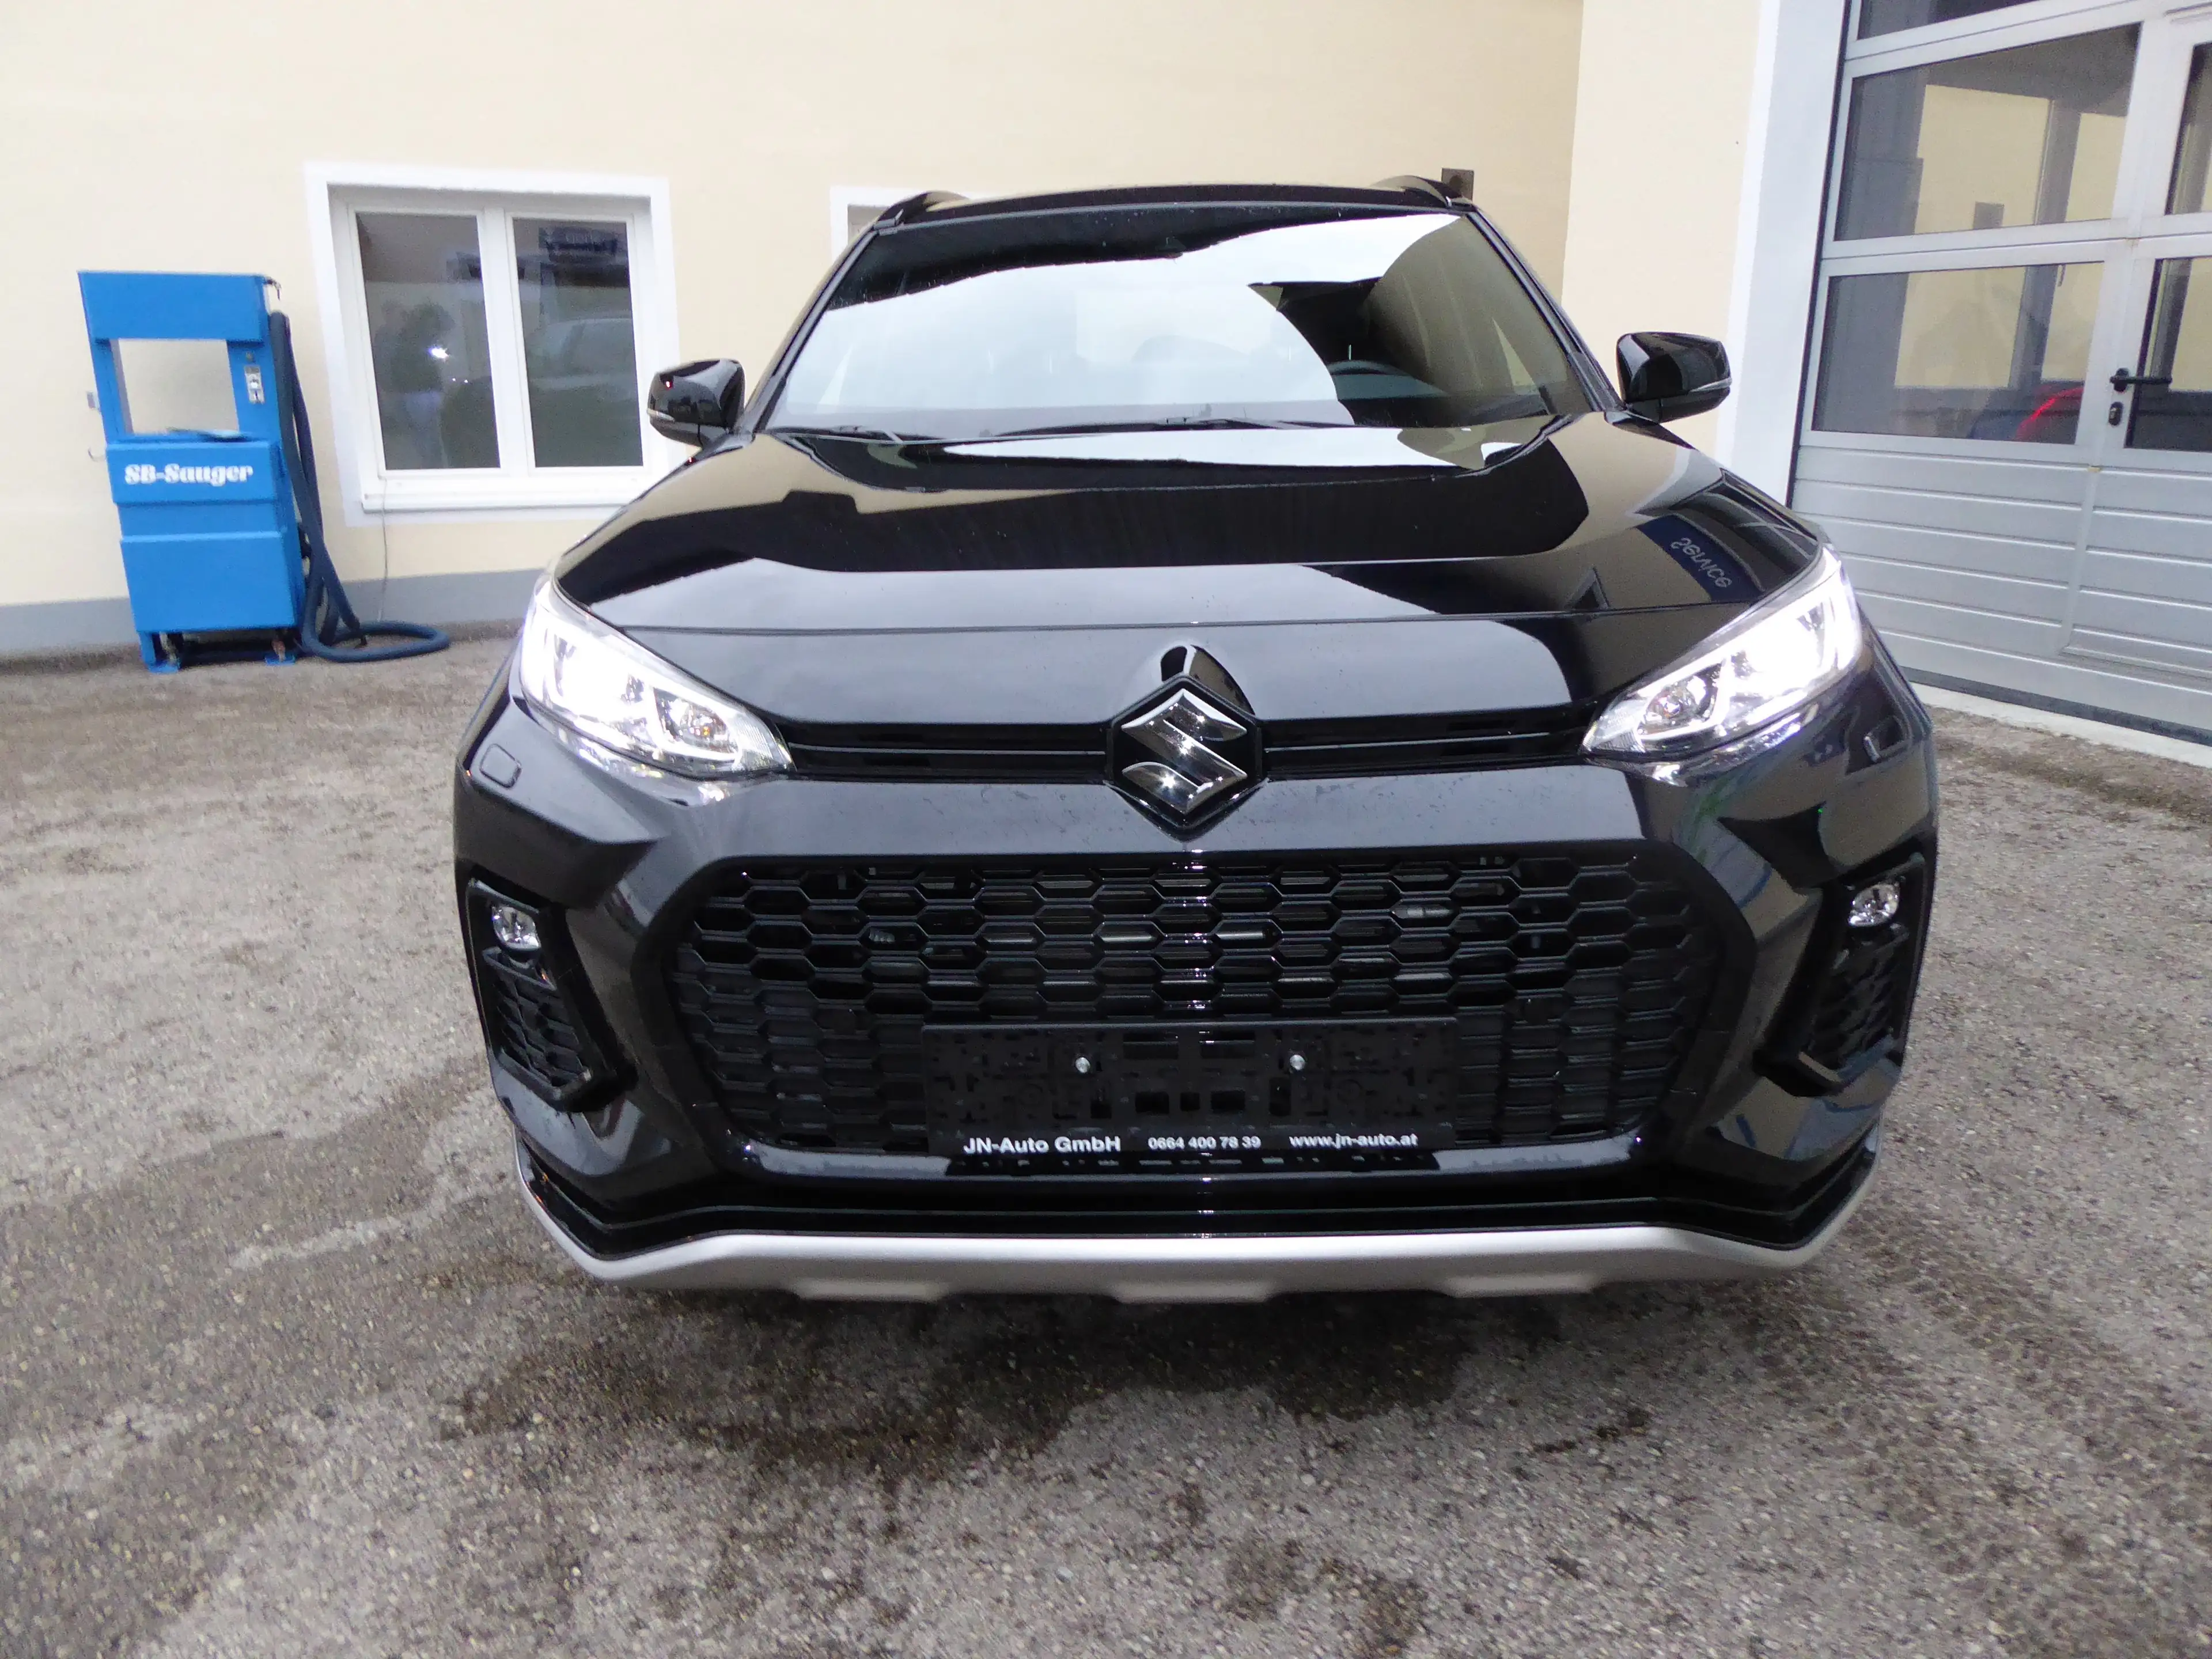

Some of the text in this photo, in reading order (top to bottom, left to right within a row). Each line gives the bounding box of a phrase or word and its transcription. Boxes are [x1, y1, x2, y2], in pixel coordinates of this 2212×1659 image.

[124, 463, 253, 487] SB-Sauger
[963, 1133, 1418, 1153] JN-Auto GmbH 0664 400 78 39 www.jn-auto.at
